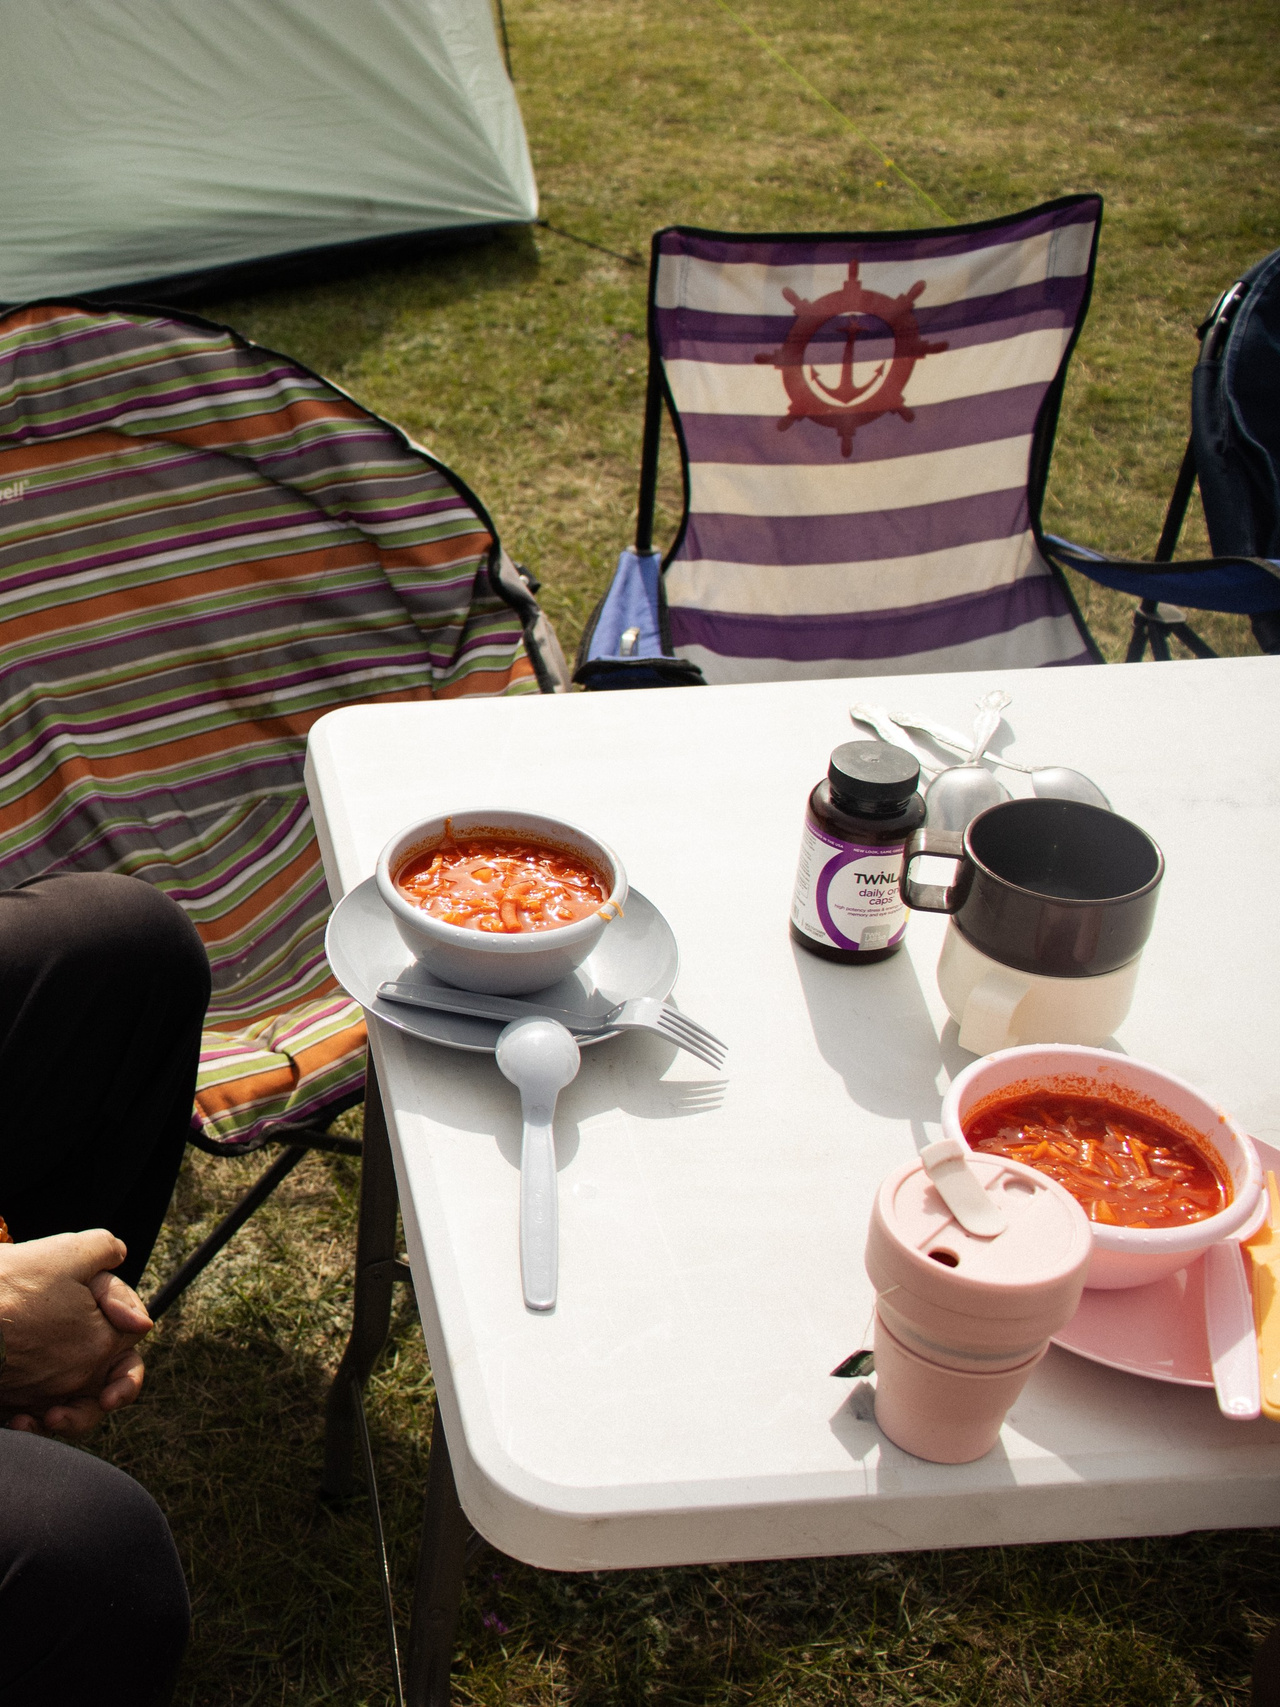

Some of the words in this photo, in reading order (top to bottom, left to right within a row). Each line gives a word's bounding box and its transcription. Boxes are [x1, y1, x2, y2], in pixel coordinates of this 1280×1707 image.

[853, 871, 902, 885] TWINL
[859, 888, 885, 898] daily
[869, 896, 893, 906] caps
